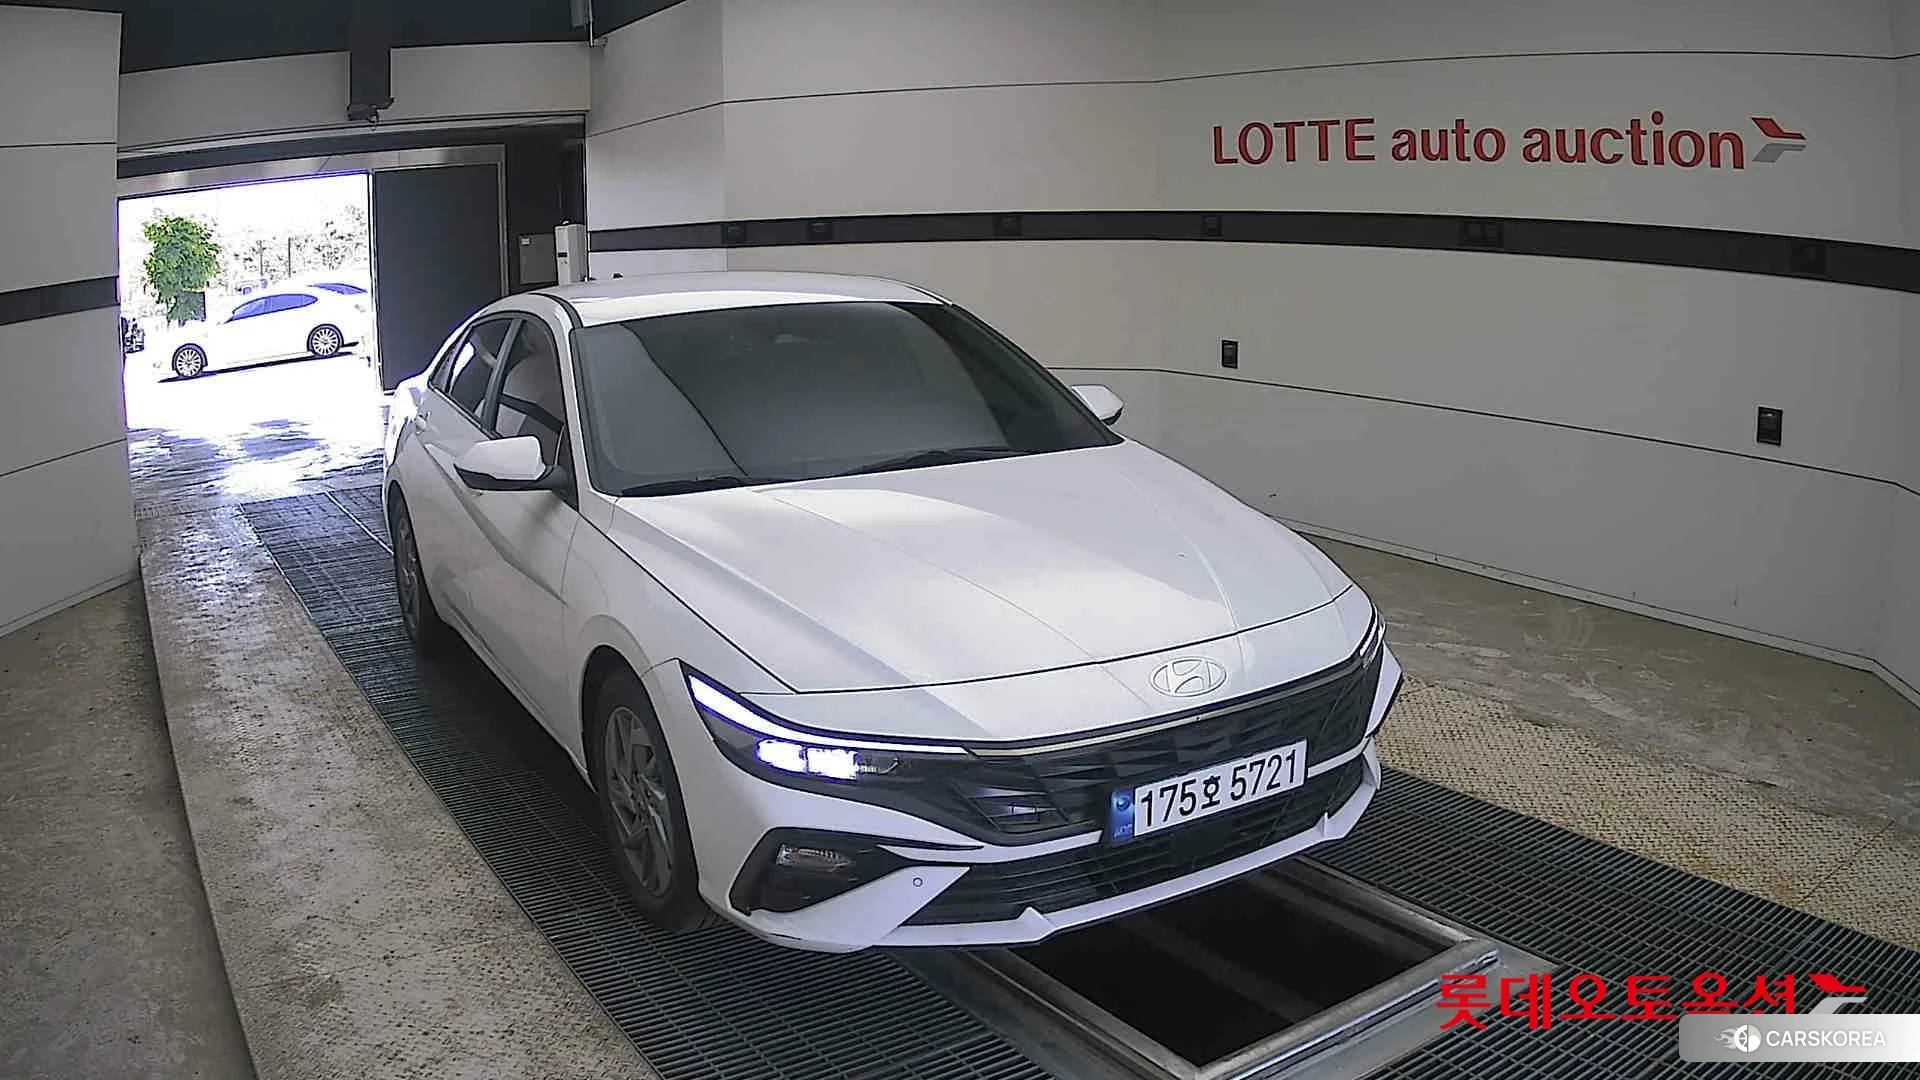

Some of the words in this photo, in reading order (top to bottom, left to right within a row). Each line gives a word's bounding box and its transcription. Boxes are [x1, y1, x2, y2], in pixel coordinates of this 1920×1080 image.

[1212, 117, 1376, 166] LOTTE
[1391, 118, 1506, 162] auto
[1522, 110, 1745, 170] auction
[1140, 776, 1222, 827] 175호
[1230, 749, 1296, 801] 5721
